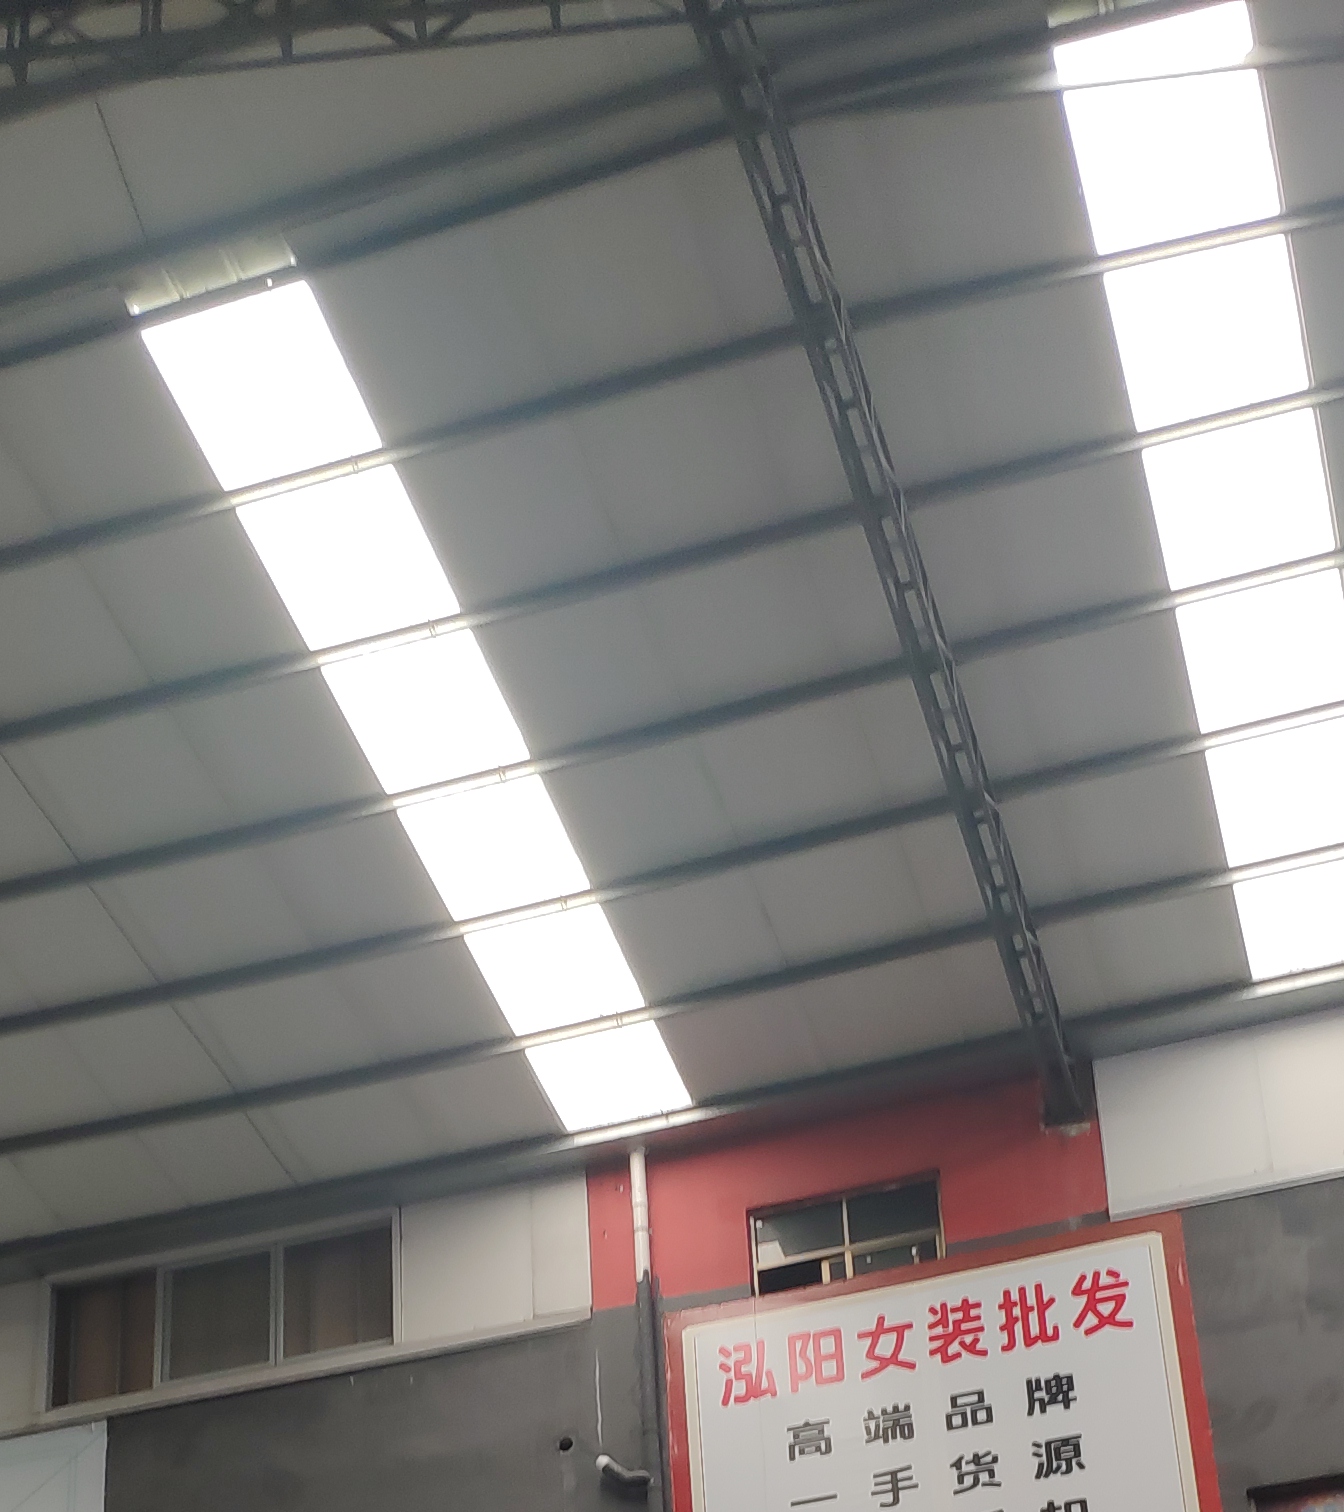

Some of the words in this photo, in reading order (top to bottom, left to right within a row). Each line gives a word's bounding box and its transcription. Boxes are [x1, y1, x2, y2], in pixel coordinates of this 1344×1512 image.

[717, 1266, 1135, 1408] 泓阳女装批发
[786, 1371, 1078, 1462] 高端品牌
[790, 1432, 1086, 1508] 一手货源
